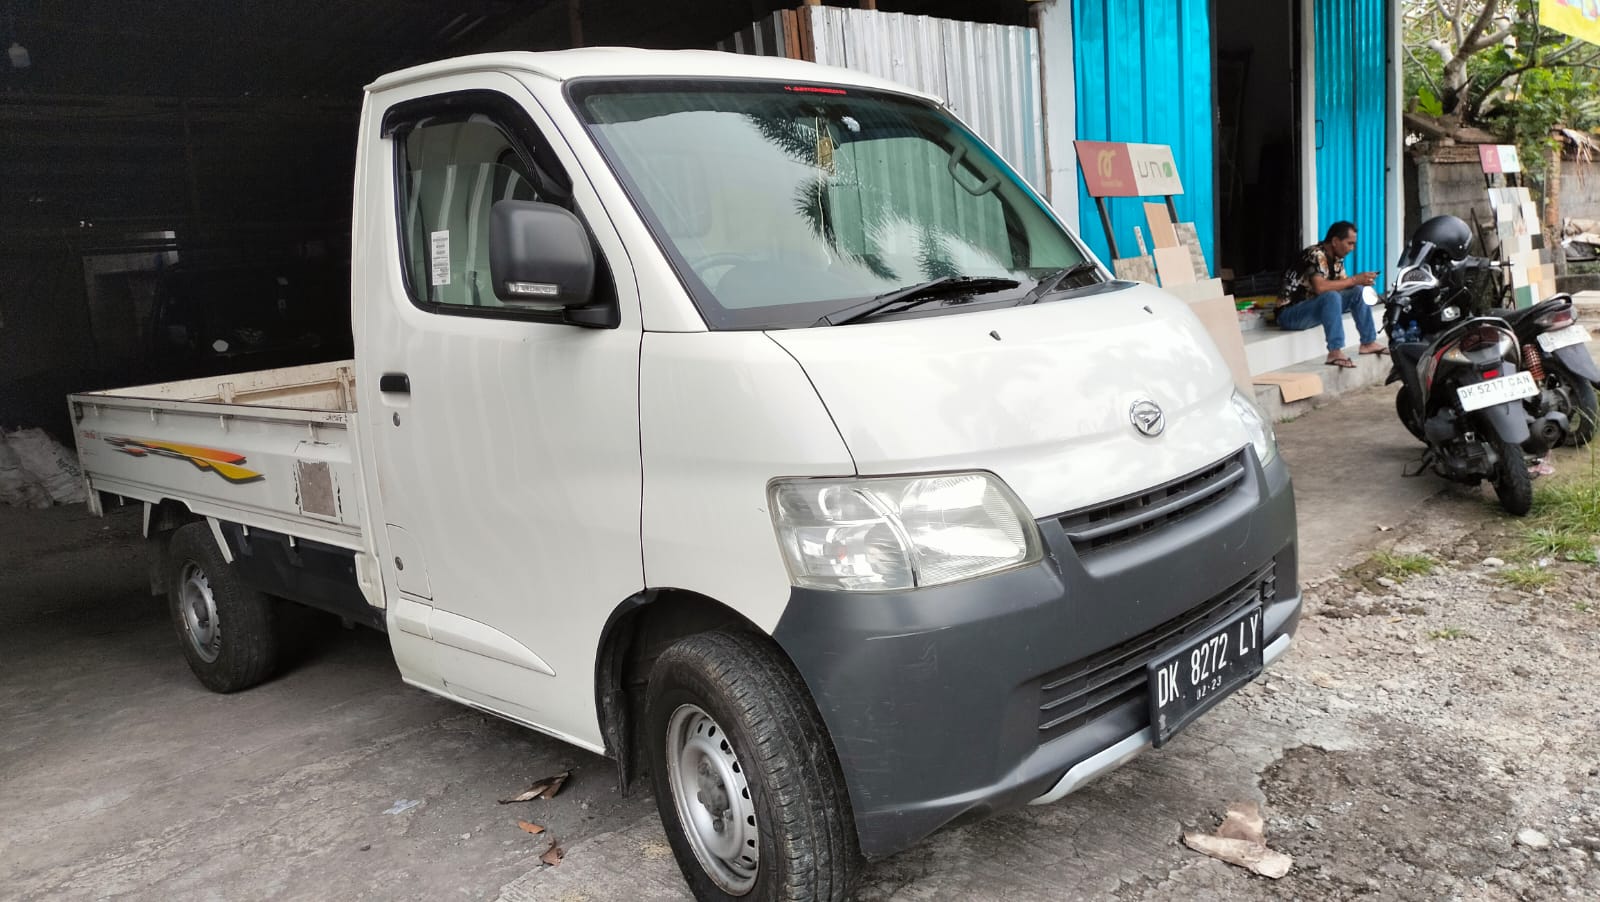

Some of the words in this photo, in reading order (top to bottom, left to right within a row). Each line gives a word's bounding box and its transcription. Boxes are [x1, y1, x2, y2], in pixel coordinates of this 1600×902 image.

[1158, 661, 1180, 708] DK
[1191, 632, 1228, 685] 8272
[1239, 613, 1258, 656] LY
